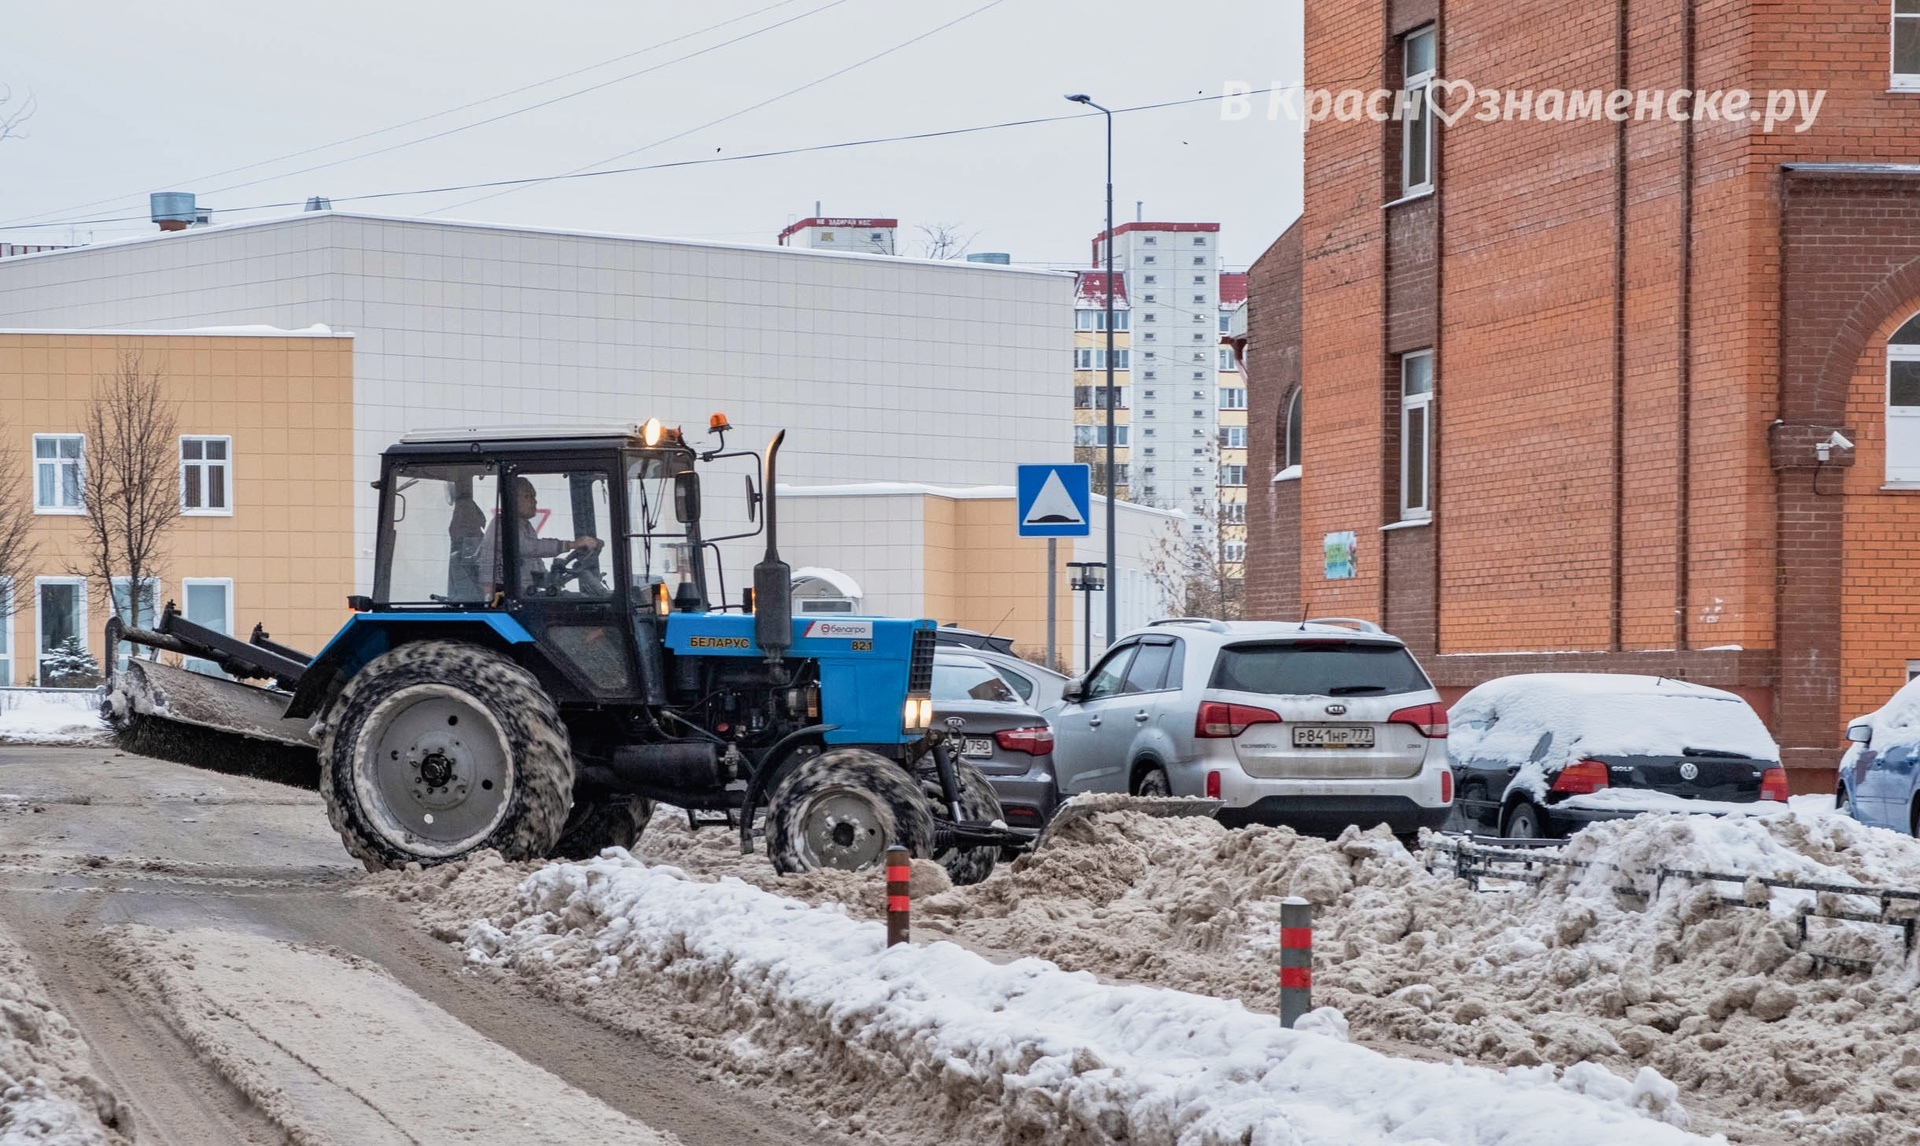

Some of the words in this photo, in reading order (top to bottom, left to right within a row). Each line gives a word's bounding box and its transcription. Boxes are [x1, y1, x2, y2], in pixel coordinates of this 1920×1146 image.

[831, 624, 866, 634] белагро
[690, 636, 750, 649] БЕЛАРУС
[1326, 705, 1346, 714] KIA
[947, 718, 964, 727] KIA
[1350, 728, 1370, 739] 777
[969, 740, 989, 750] 750
